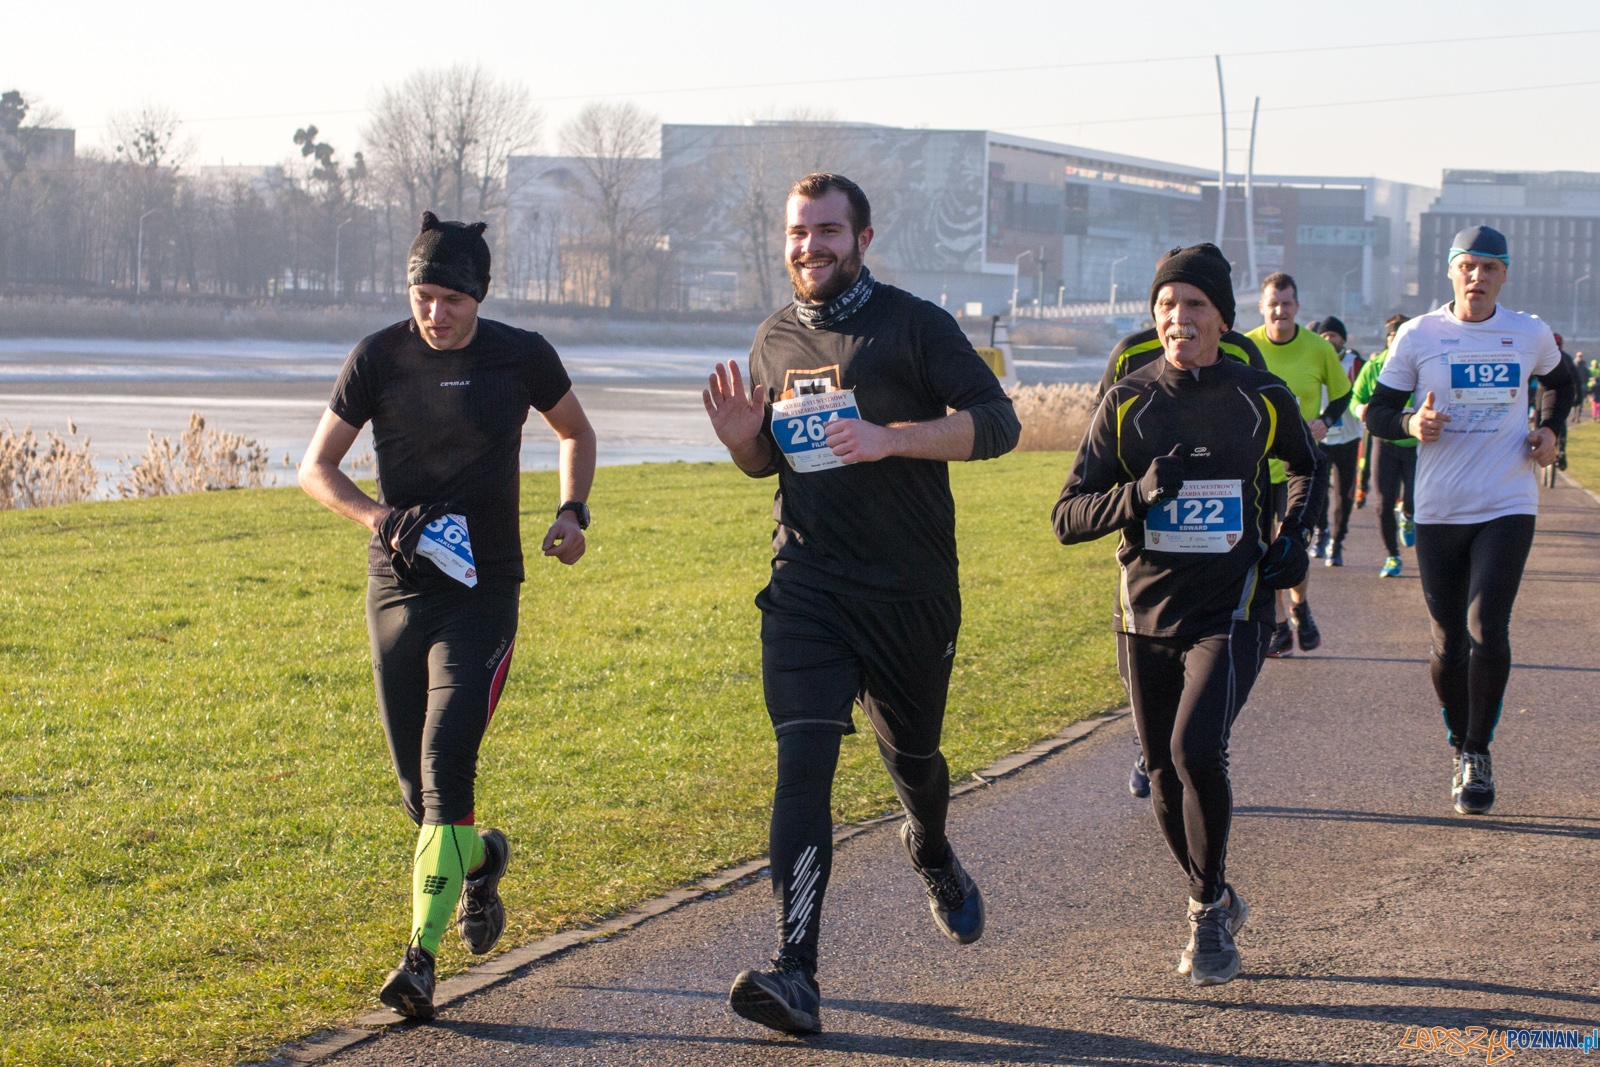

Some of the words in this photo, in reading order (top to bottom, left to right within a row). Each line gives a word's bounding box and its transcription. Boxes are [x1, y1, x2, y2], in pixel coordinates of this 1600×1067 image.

[1464, 364, 1509, 383] 192
[806, 394, 847, 407] SYLWESTROWY
[819, 401, 847, 411] BURGIELA
[787, 412, 839, 445] 26
[1163, 499, 1224, 524] 122
[435, 537, 457, 551] JAKUB
